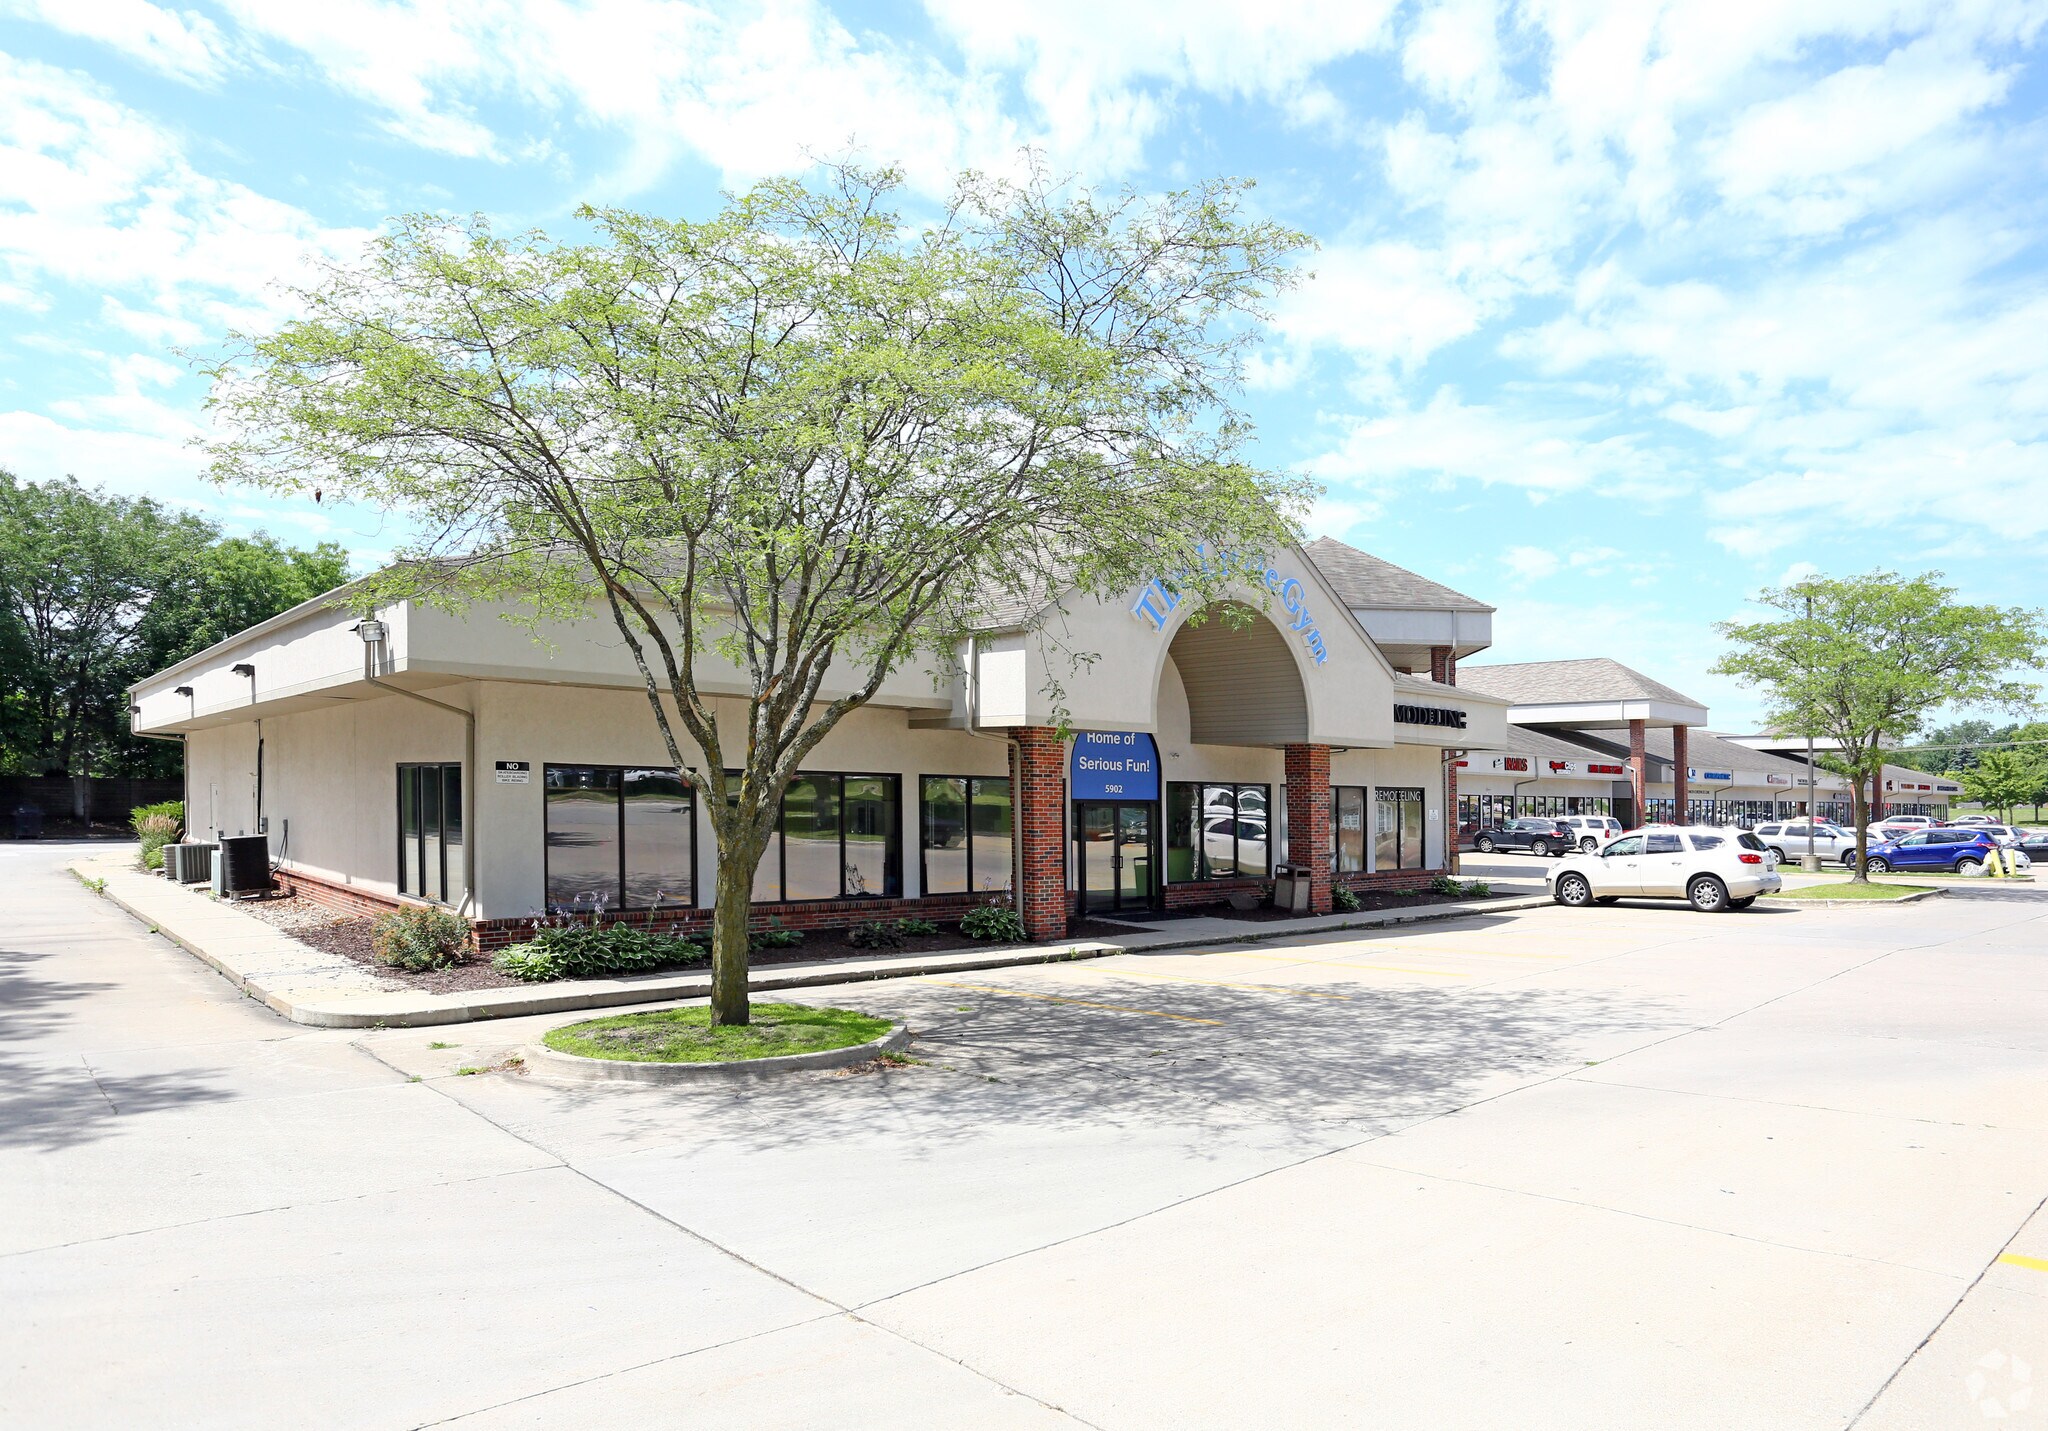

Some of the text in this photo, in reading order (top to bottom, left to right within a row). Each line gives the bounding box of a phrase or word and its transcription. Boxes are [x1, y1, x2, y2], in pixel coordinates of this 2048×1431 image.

[1279, 577, 1328, 667] Gym
[1086, 732, 1135, 745] Home of
[506, 762, 519, 770] NO
[1079, 756, 1150, 772] Serious Fun!
[1105, 785, 1123, 793] 5902
